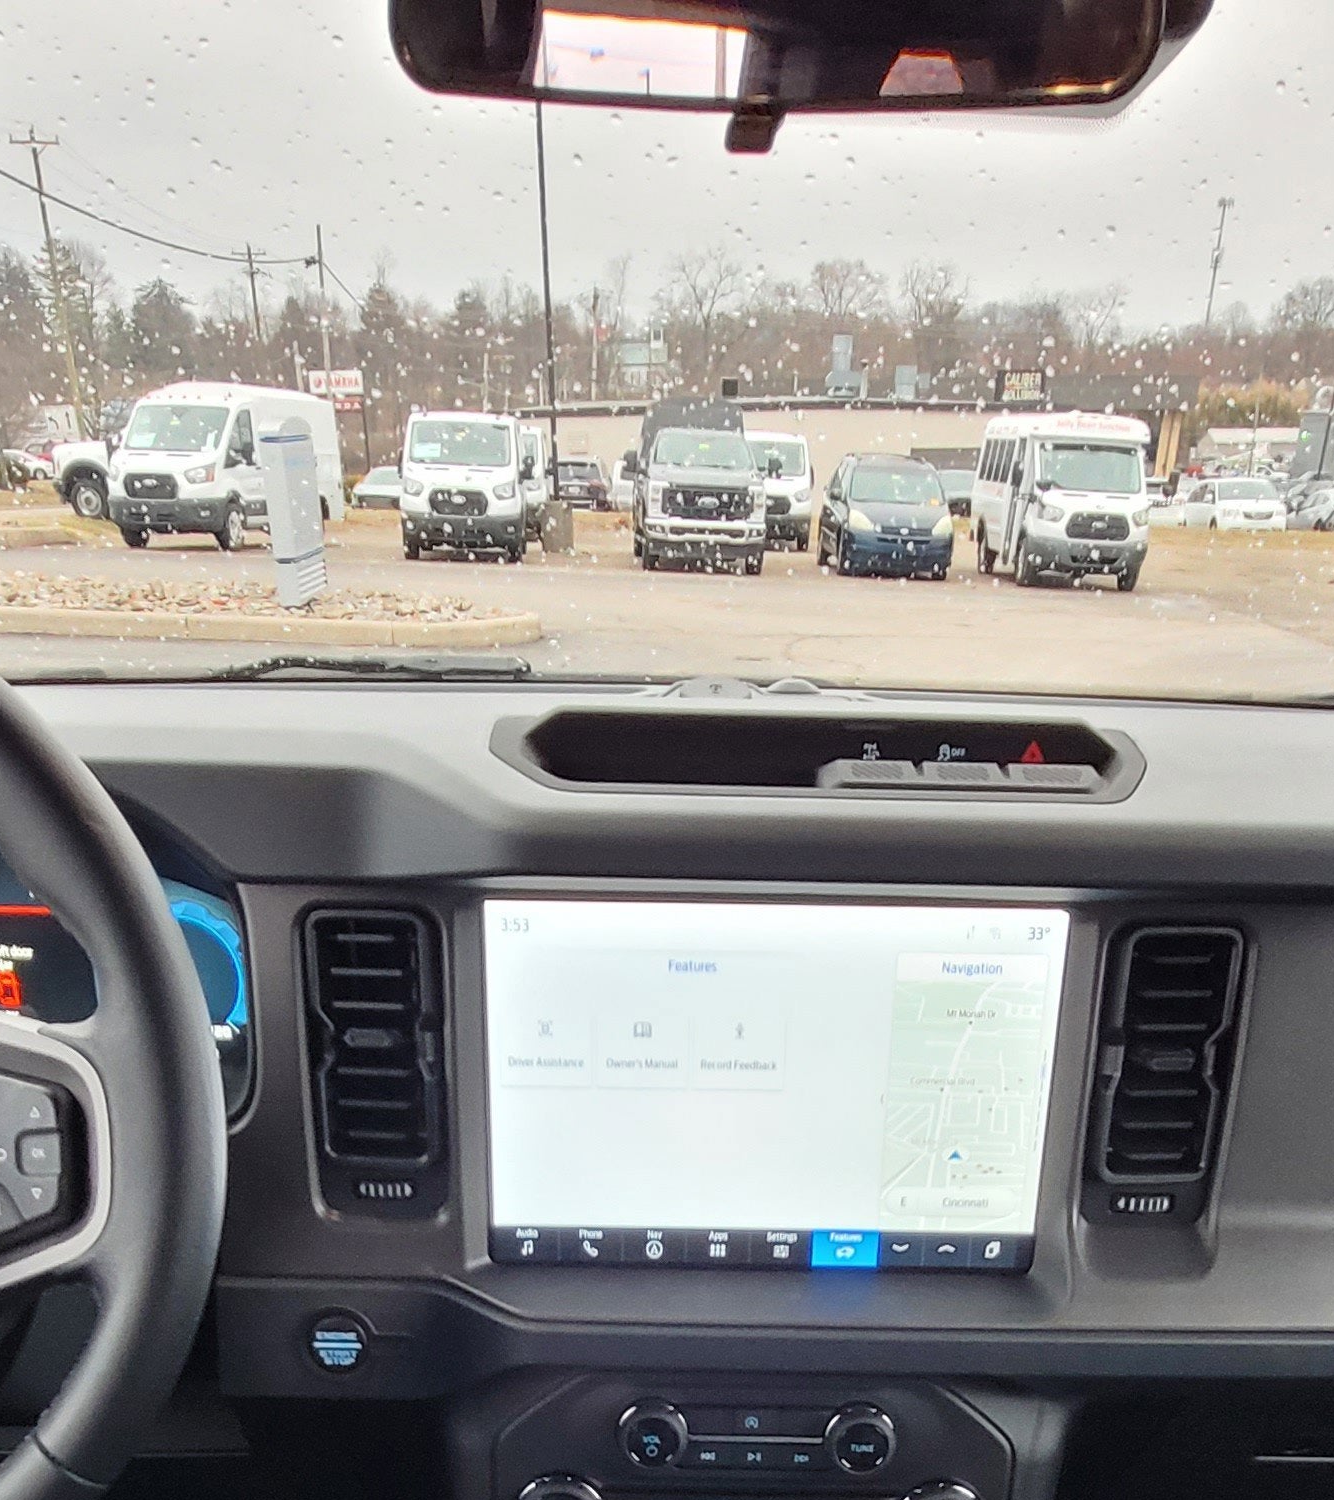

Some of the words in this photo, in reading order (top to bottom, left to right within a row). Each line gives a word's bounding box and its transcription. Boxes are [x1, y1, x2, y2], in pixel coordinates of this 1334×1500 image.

[1005, 372, 1042, 387] CALIBER
[950, 747, 966, 757] OFF
[501, 917, 530, 933] 3:53
[668, 958, 717, 973] Features
[941, 961, 1003, 976] Navigation
[508, 1056, 534, 1068] Driver
[536, 1056, 585, 1069] Assistance
[605, 1057, 643, 1069] Owner's
[644, 1057, 678, 1070] Manual
[700, 1059, 732, 1071] Record
[733, 1059, 777, 1071] Feedback
[900, 1196, 907, 1207] E
[942, 1197, 989, 1208] Cincinnati
[515, 1227, 539, 1239] Audio
[578, 1228, 603, 1240] Phone
[647, 1229, 663, 1240] Nav
[708, 1230, 729, 1243] Apps
[767, 1231, 798, 1244] Settings
[830, 1232, 863, 1243] Features
